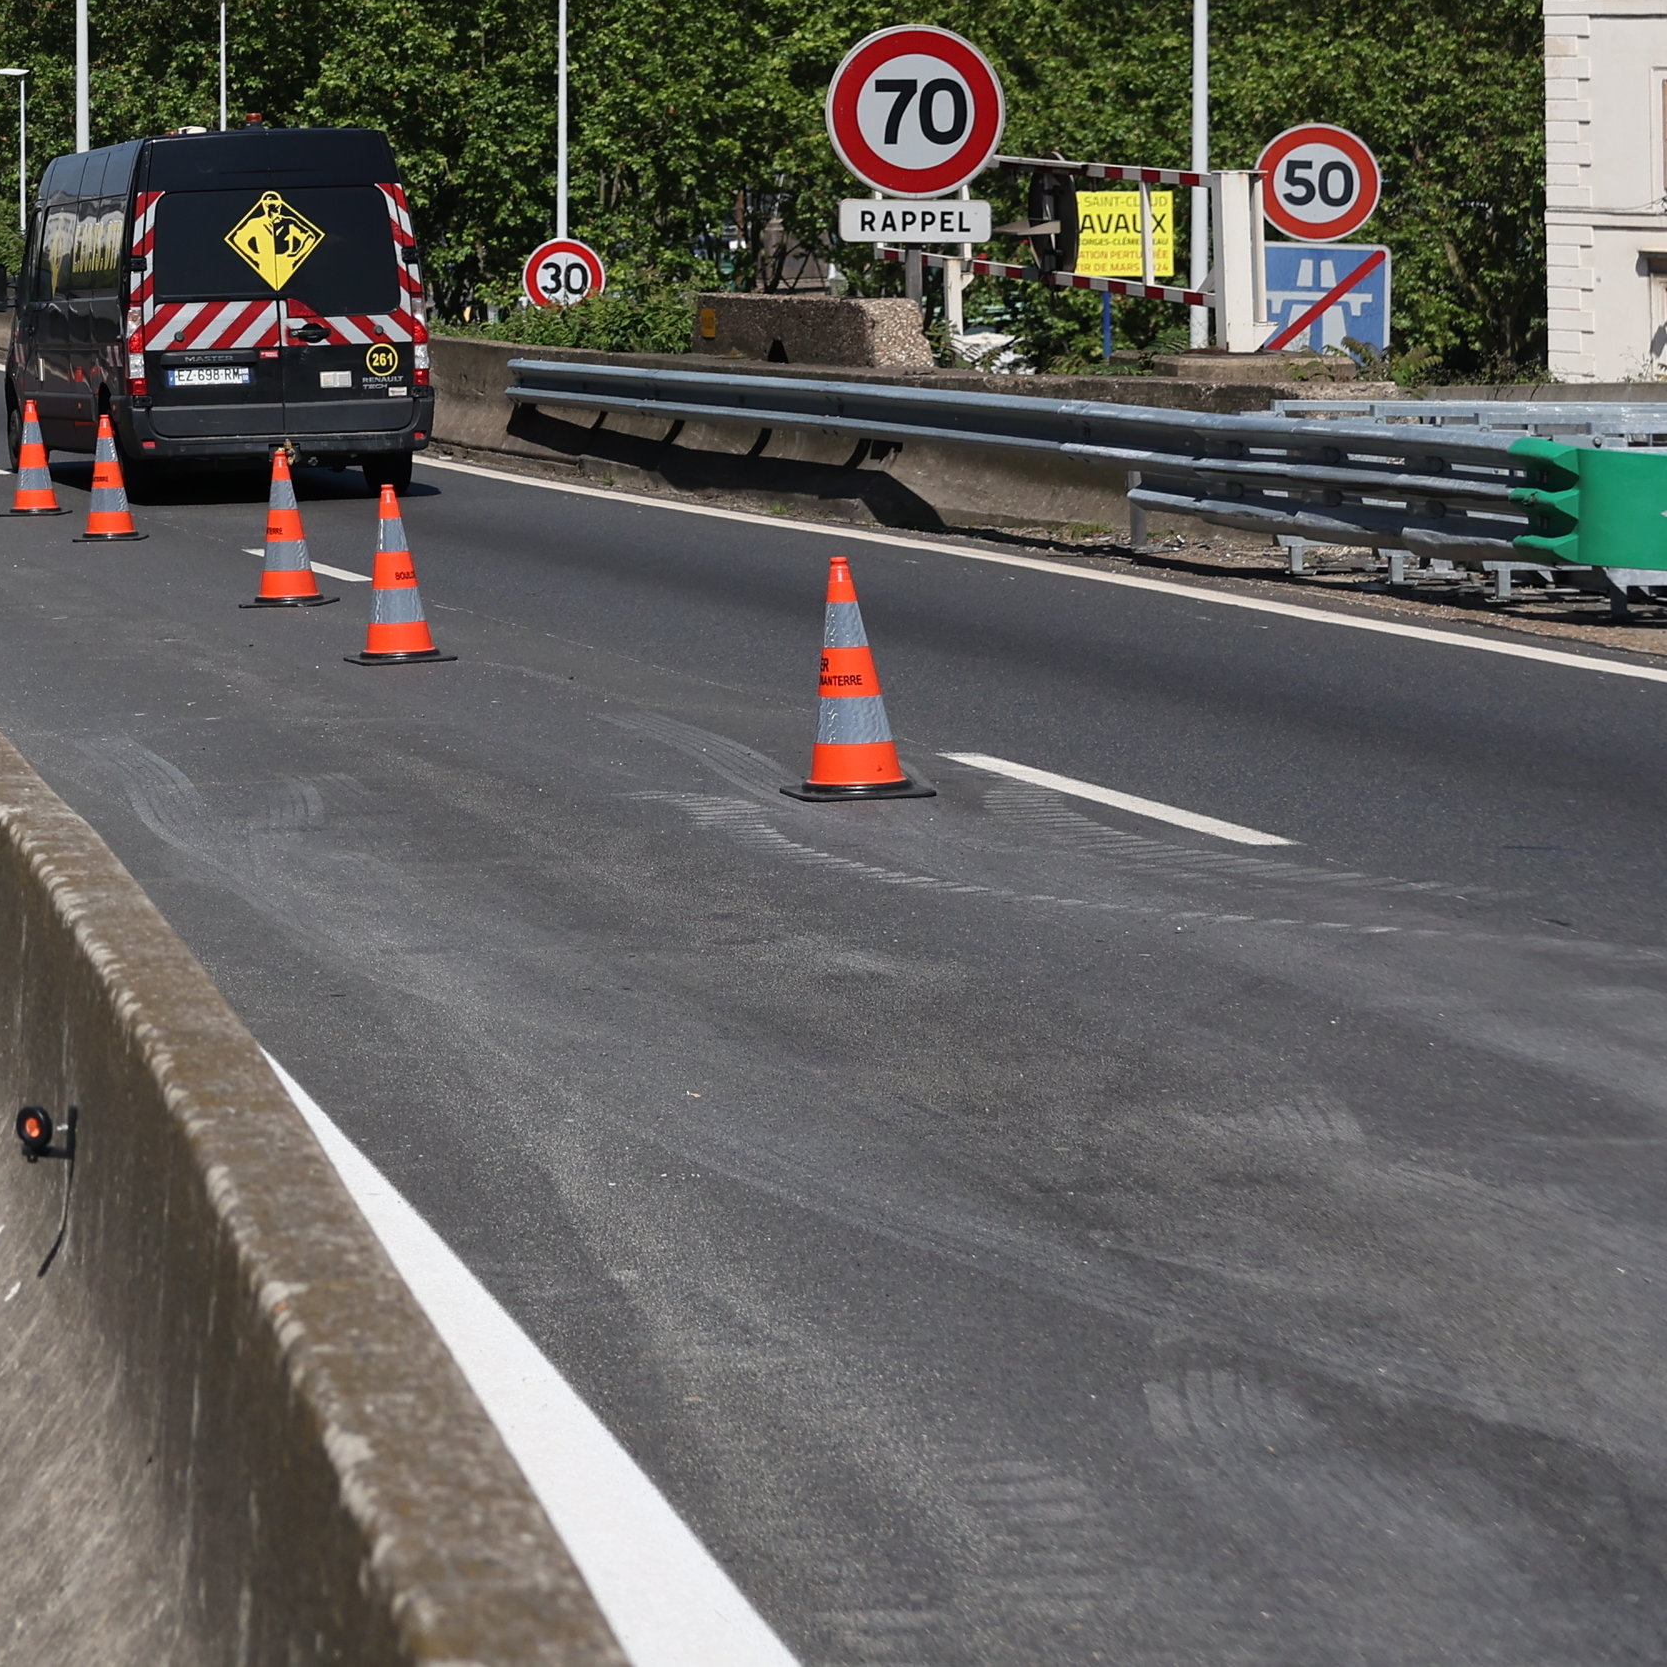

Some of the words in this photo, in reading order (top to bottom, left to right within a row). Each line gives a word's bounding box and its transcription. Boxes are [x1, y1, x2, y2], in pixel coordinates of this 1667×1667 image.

[875, 78, 967, 145] 70
[1282, 160, 1353, 207] 50
[1084, 196, 1168, 207] SAINT-CLUD
[860, 210, 971, 232] RAPPEL
[1079, 213, 1166, 233] AVAUX
[1111, 262, 1140, 272] MARS
[540, 262, 587, 294] 30
[184, 355, 234, 363] MASTER
[372, 353, 393, 366] 261
[362, 375, 404, 383] RENAULT
